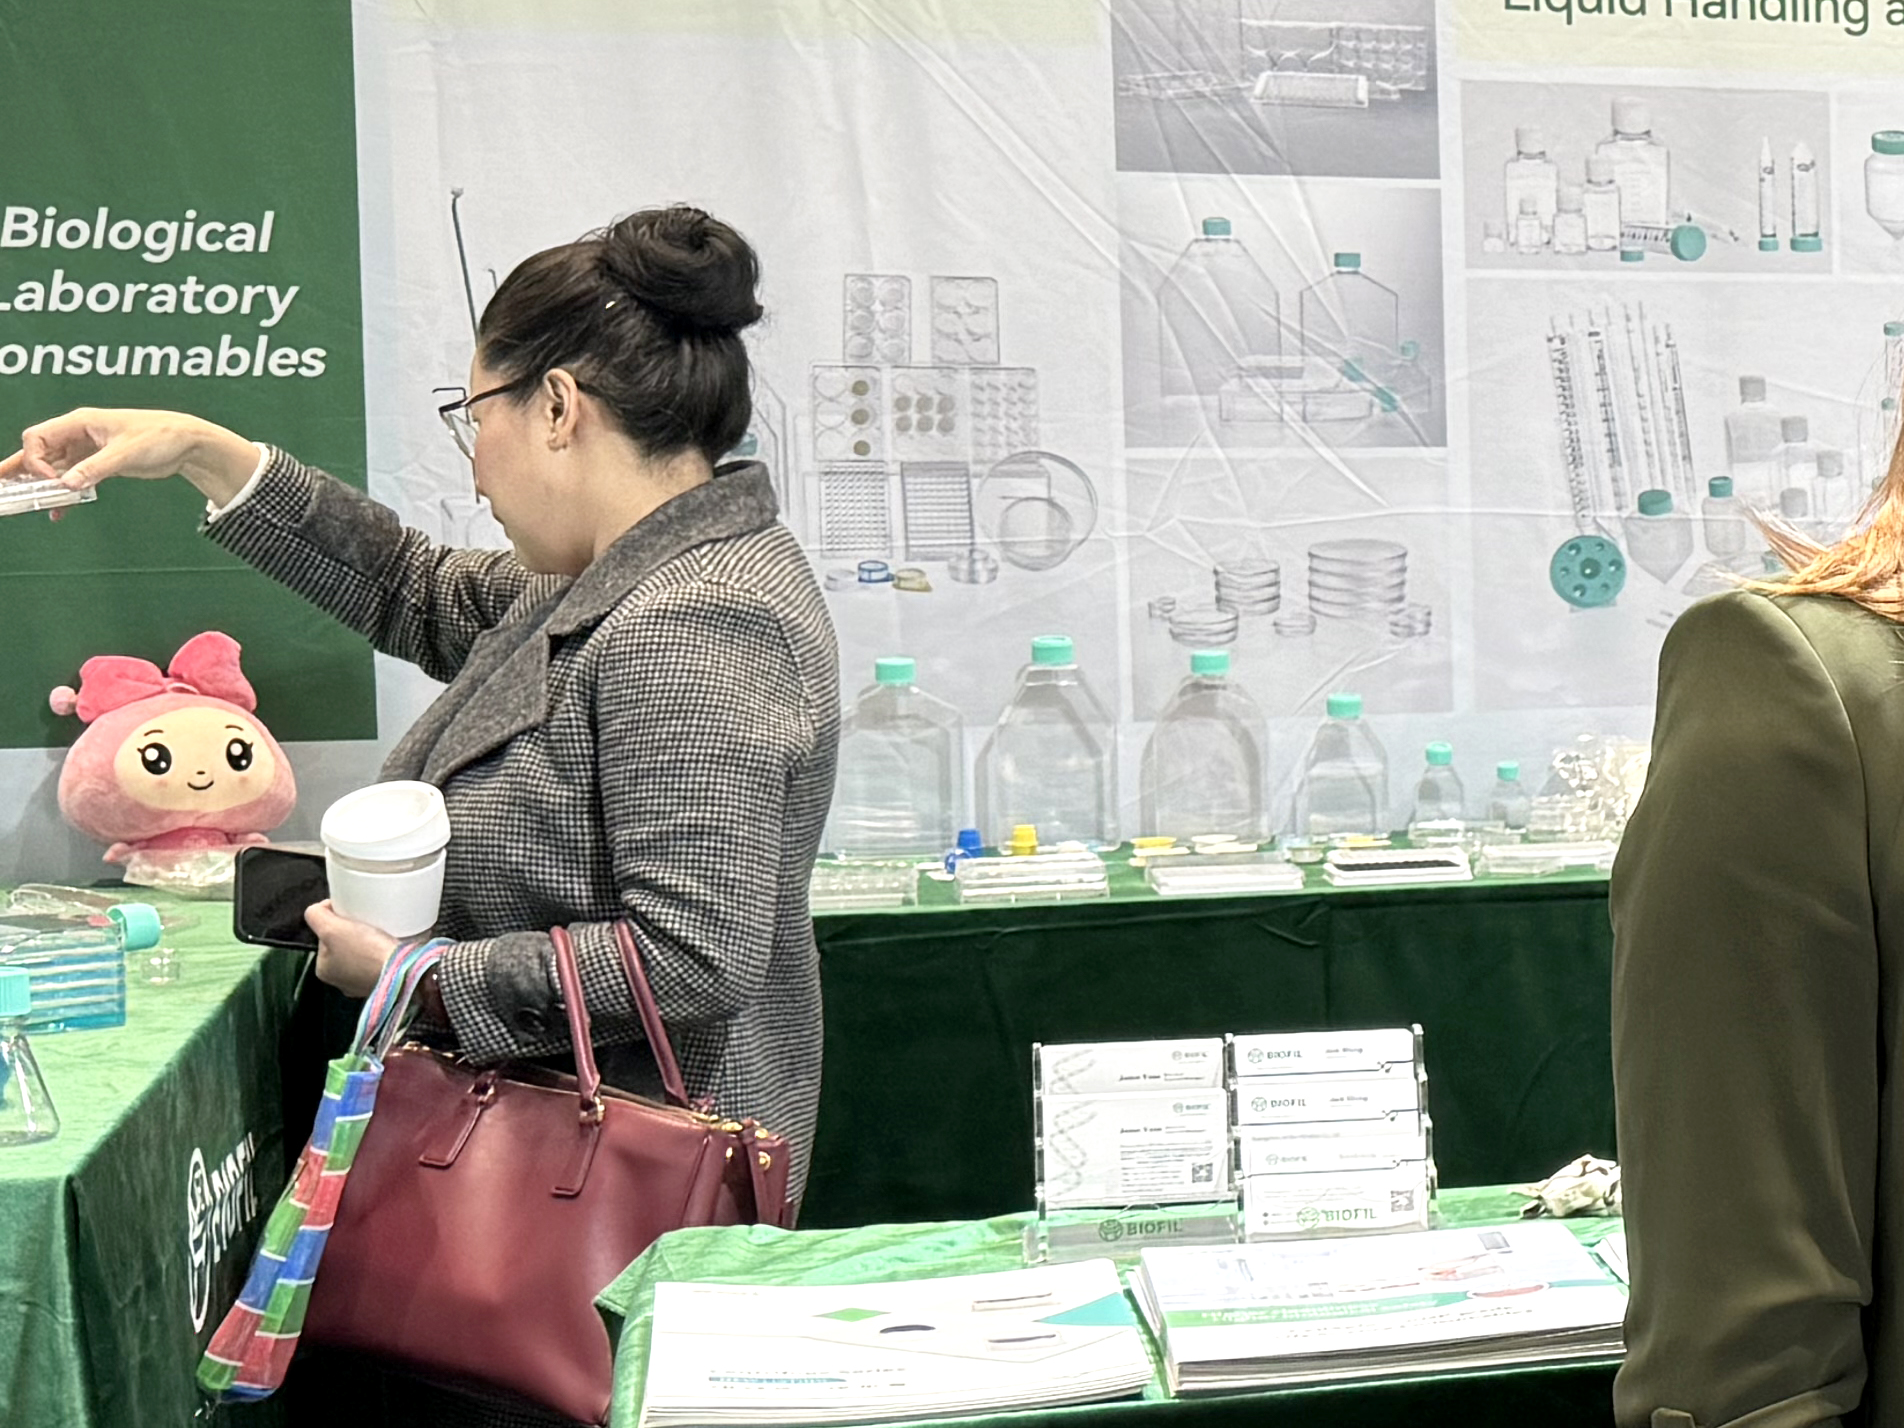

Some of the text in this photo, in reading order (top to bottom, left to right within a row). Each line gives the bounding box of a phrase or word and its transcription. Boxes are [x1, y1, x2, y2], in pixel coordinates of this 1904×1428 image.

[0, 206, 275, 263] Biological
[0, 269, 299, 328] aboratory
[1126, 1219, 1183, 1236] BIOFIL
